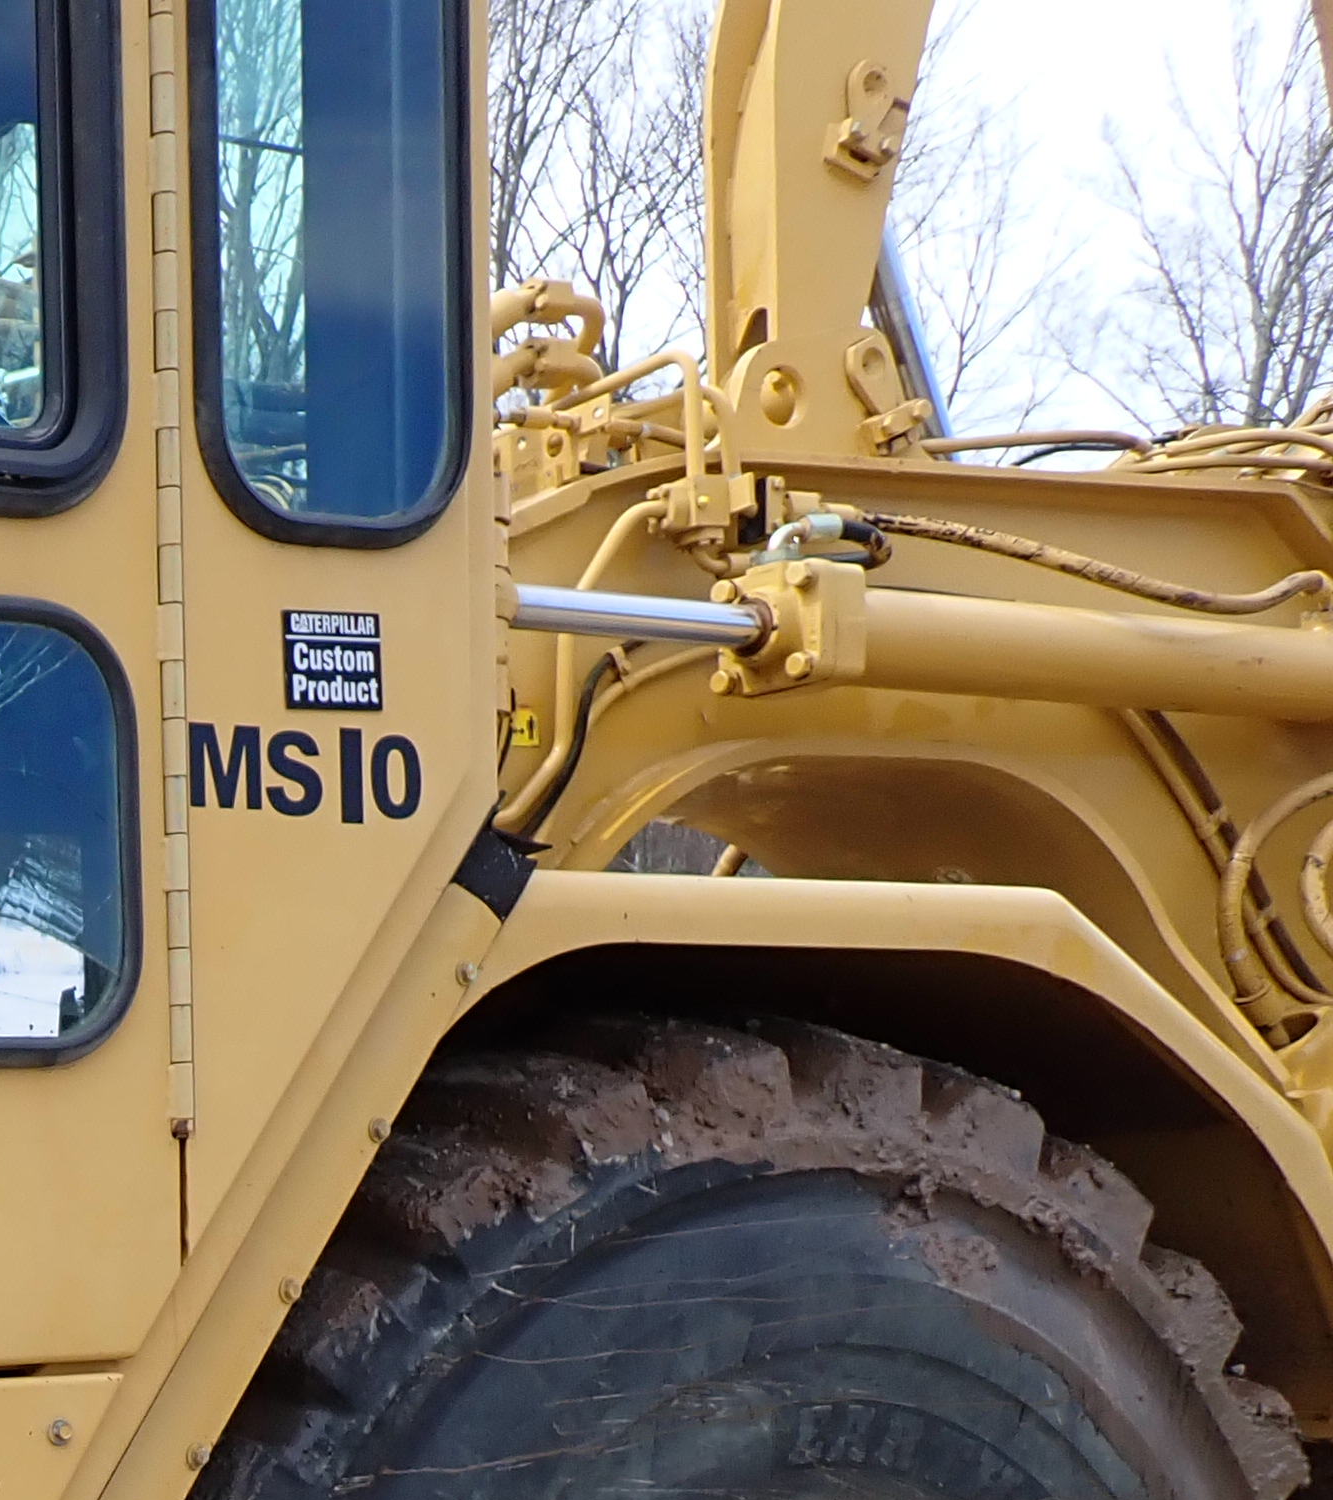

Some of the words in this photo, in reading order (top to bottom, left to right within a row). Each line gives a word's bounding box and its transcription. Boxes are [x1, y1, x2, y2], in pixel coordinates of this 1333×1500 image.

[290, 613, 375, 635] CATERPILLAR
[293, 642, 375, 672] Custom
[292, 674, 379, 704] Product
